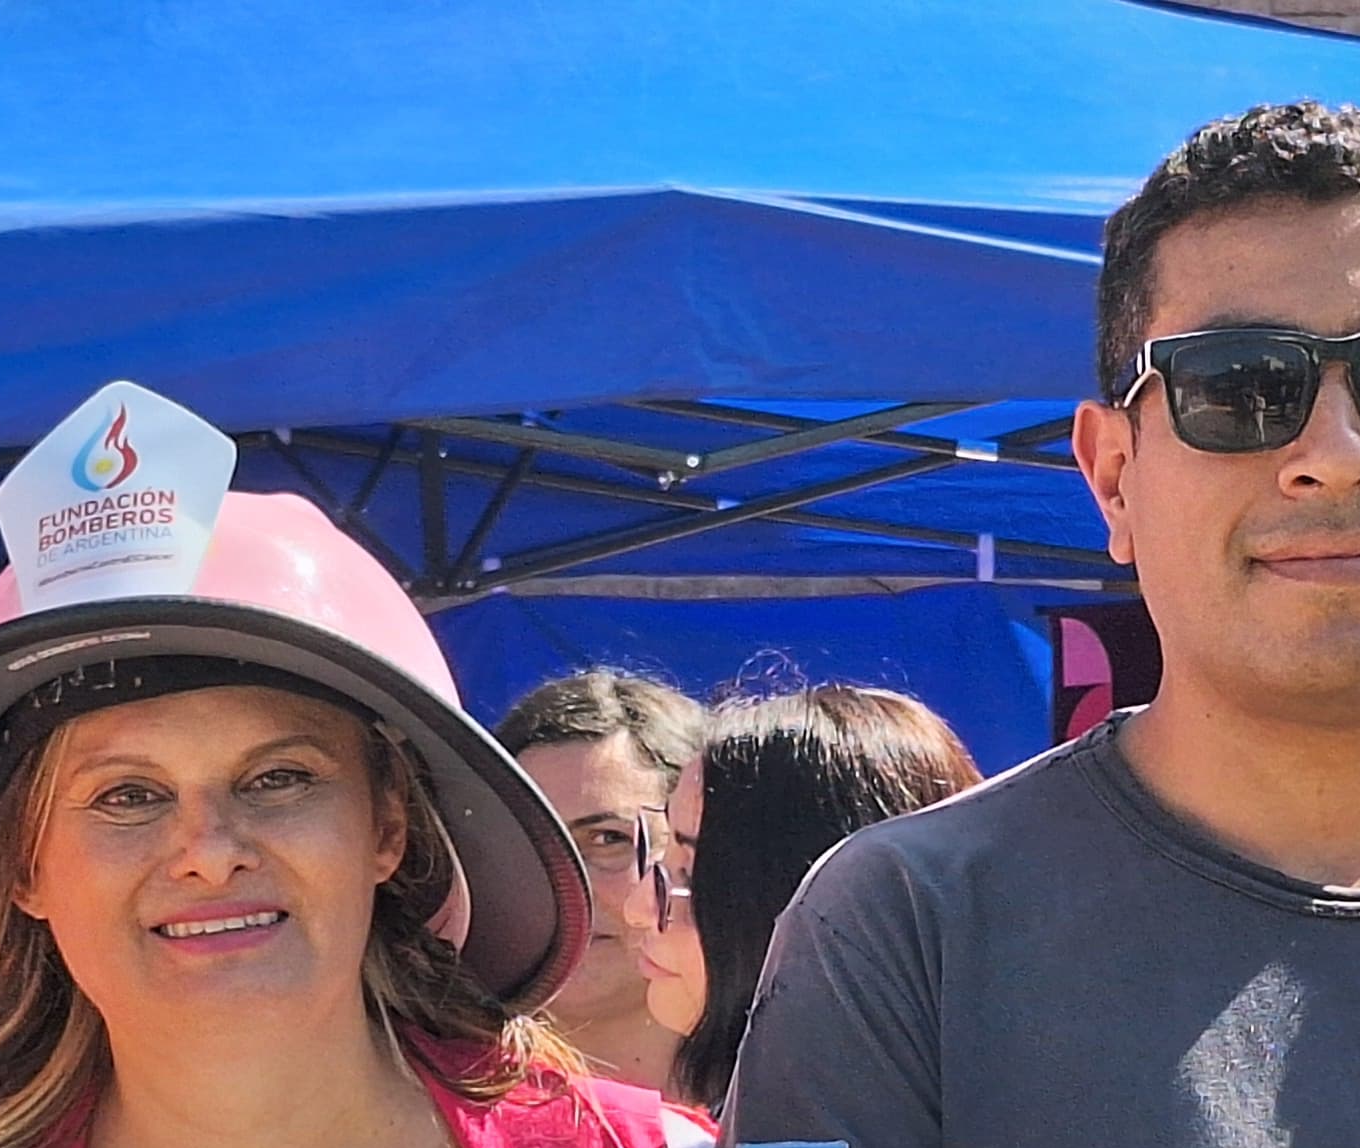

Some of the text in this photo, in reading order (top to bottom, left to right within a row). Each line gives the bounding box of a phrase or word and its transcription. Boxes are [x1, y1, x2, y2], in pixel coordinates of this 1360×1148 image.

[39, 487, 176, 534] FUNDACIÓN
[39, 508, 174, 552] BOMBEROS
[37, 526, 173, 569] DE ARGENTINA
